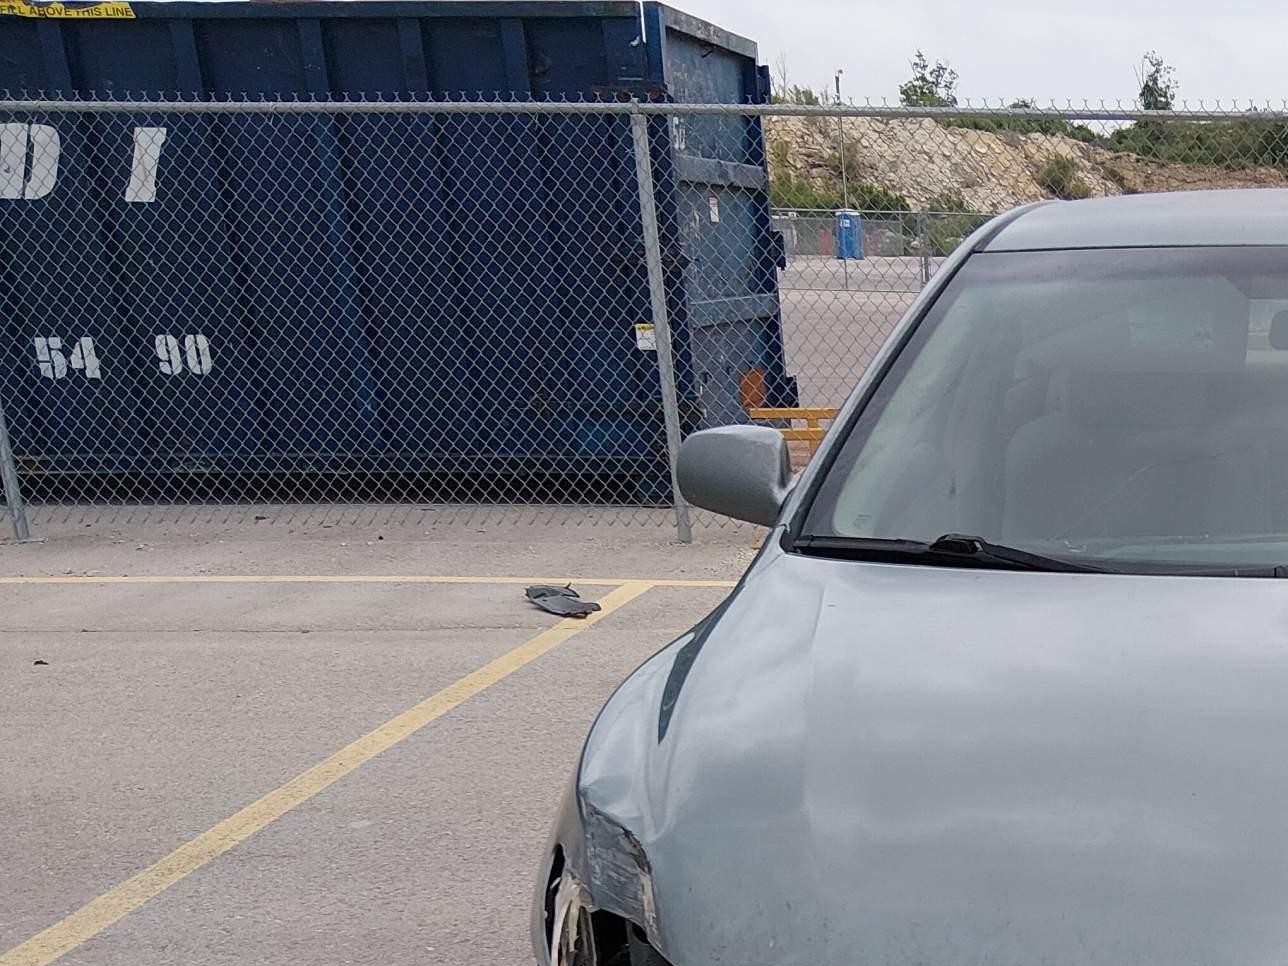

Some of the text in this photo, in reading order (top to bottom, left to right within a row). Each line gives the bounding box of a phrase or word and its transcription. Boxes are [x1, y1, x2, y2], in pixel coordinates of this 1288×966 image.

[29, 6, 72, 17] ABOVE
[75, 7, 102, 17] THIS
[105, 7, 133, 17] LINE
[34, 334, 213, 380] 54 90
